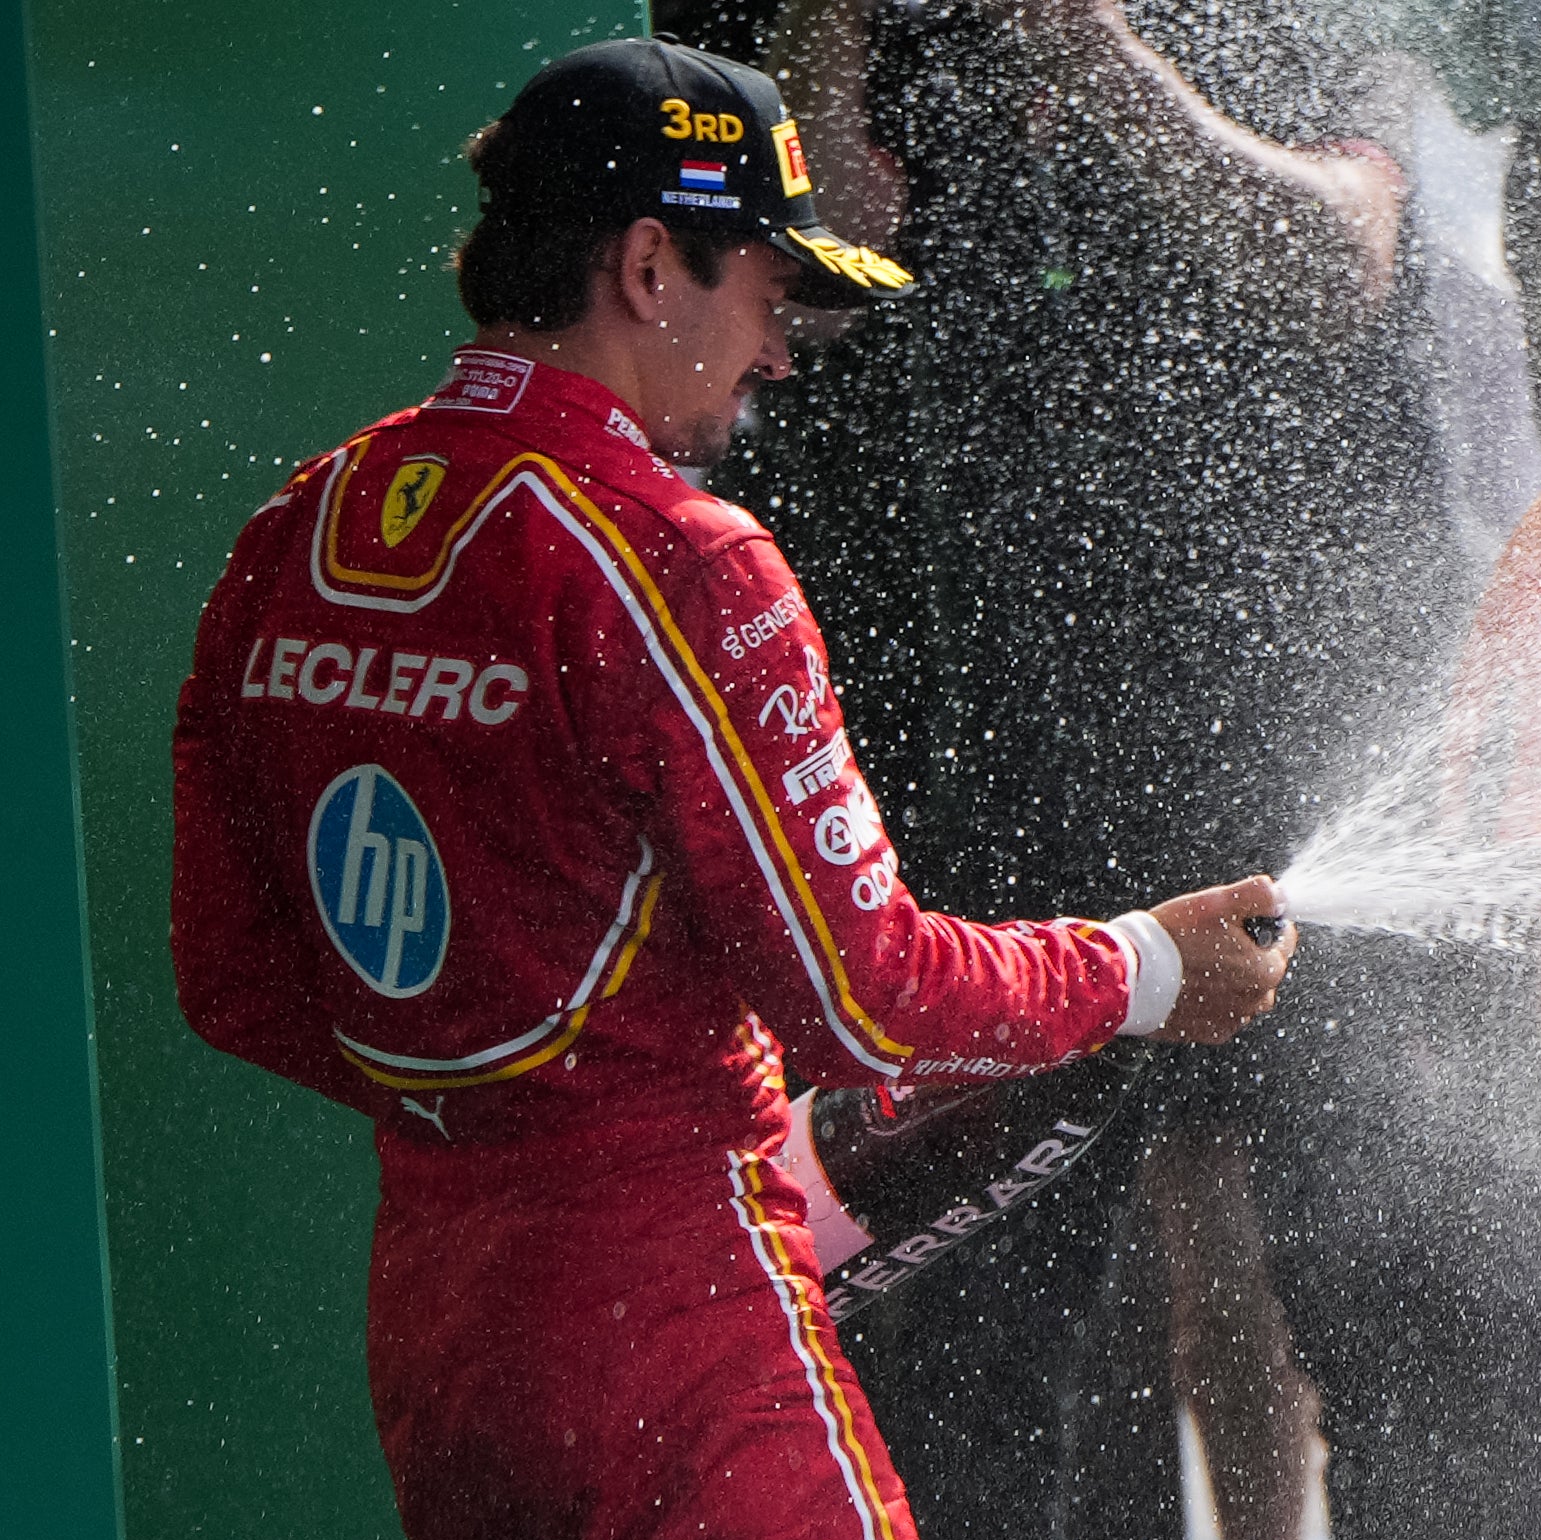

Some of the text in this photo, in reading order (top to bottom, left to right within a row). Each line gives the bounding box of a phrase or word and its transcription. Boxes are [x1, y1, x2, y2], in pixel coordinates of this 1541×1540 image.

[660, 98, 744, 144] 3RD
[240, 637, 529, 726] LECLERC
[337, 775, 429, 990] hp
[825, 1118, 1098, 1320] FERRARI
